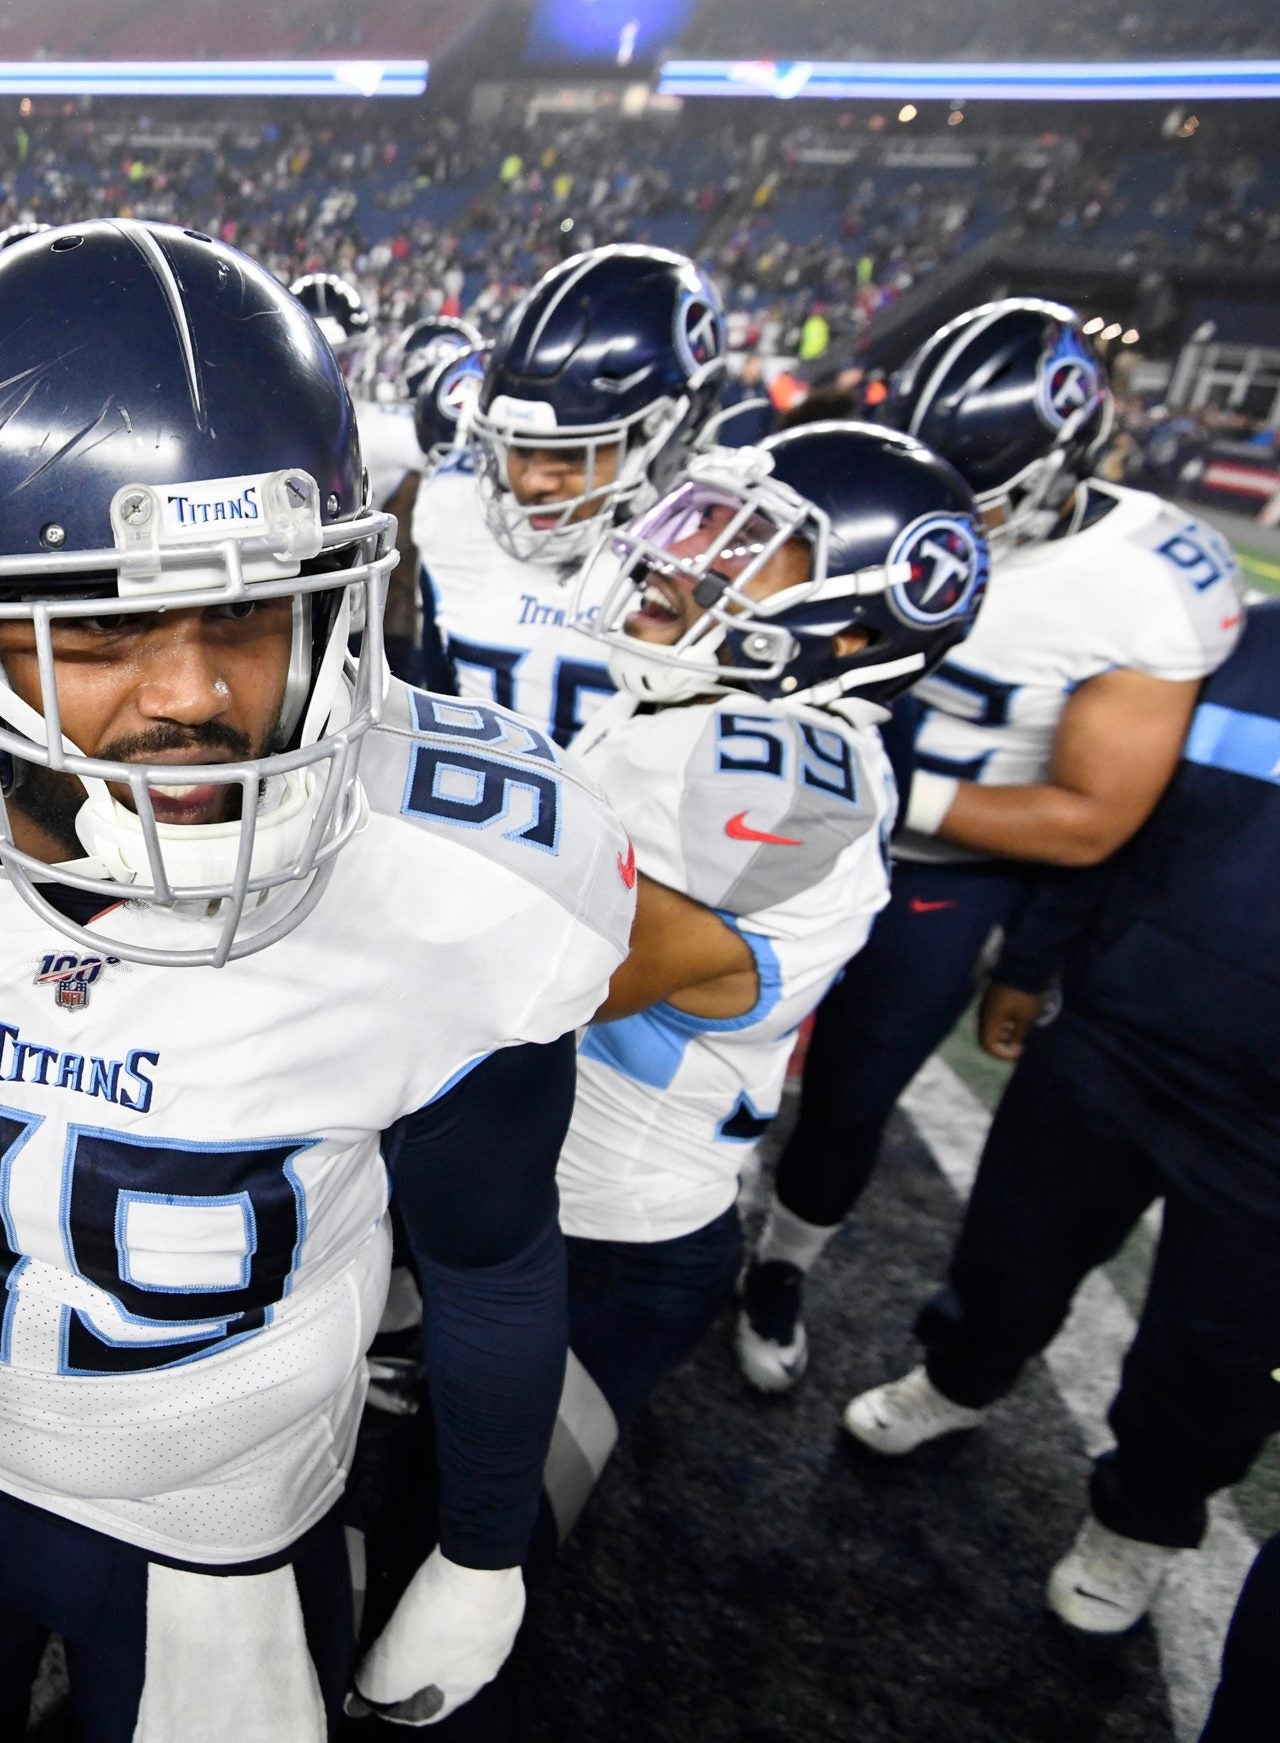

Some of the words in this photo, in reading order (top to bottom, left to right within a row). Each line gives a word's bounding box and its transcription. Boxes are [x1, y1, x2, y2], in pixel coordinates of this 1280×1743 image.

[168, 487, 258, 528] TITANS
[714, 711, 862, 809] 59
[37, 952, 104, 986] 100
